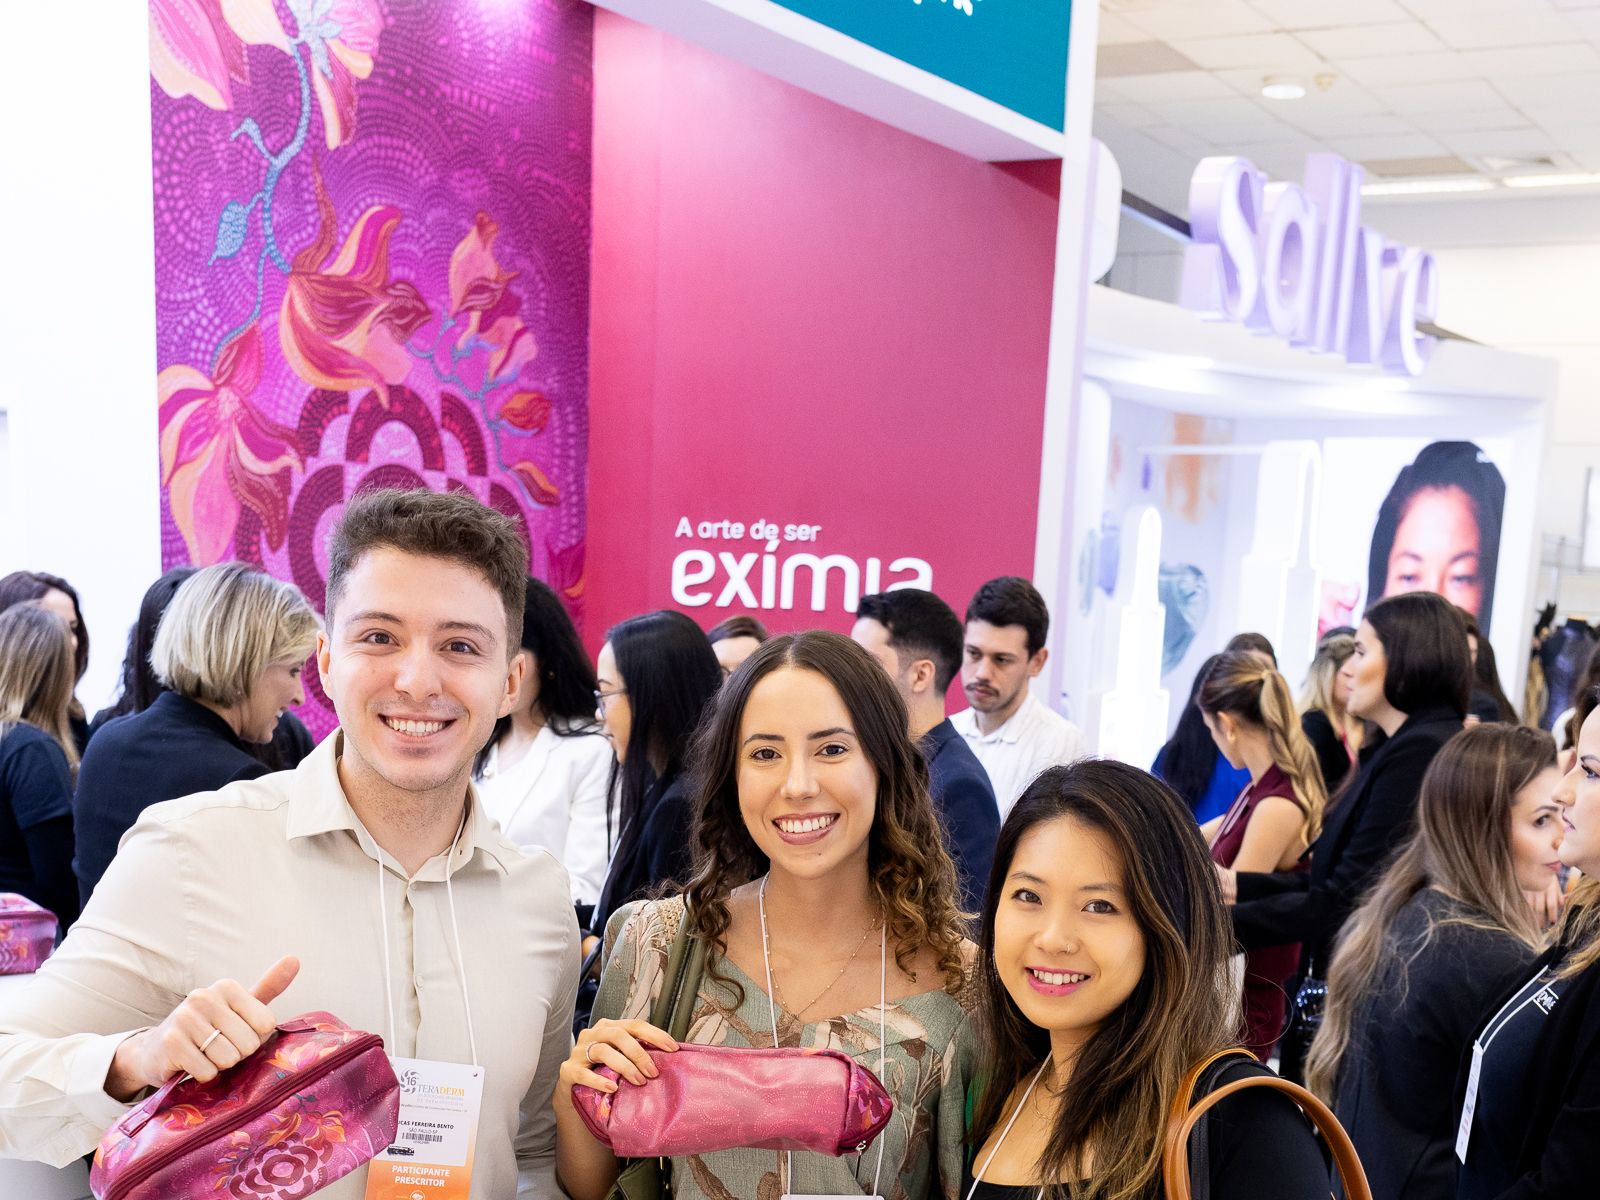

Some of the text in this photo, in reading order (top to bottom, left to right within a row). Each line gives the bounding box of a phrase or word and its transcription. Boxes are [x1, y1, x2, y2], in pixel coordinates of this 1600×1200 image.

[674, 516, 822, 542] A arte de ser
[417, 1084, 465, 1097] TERADERM
[392, 1164, 451, 1177] PARTICIPANTE
[394, 1176, 445, 1188] PRESCRITOR
